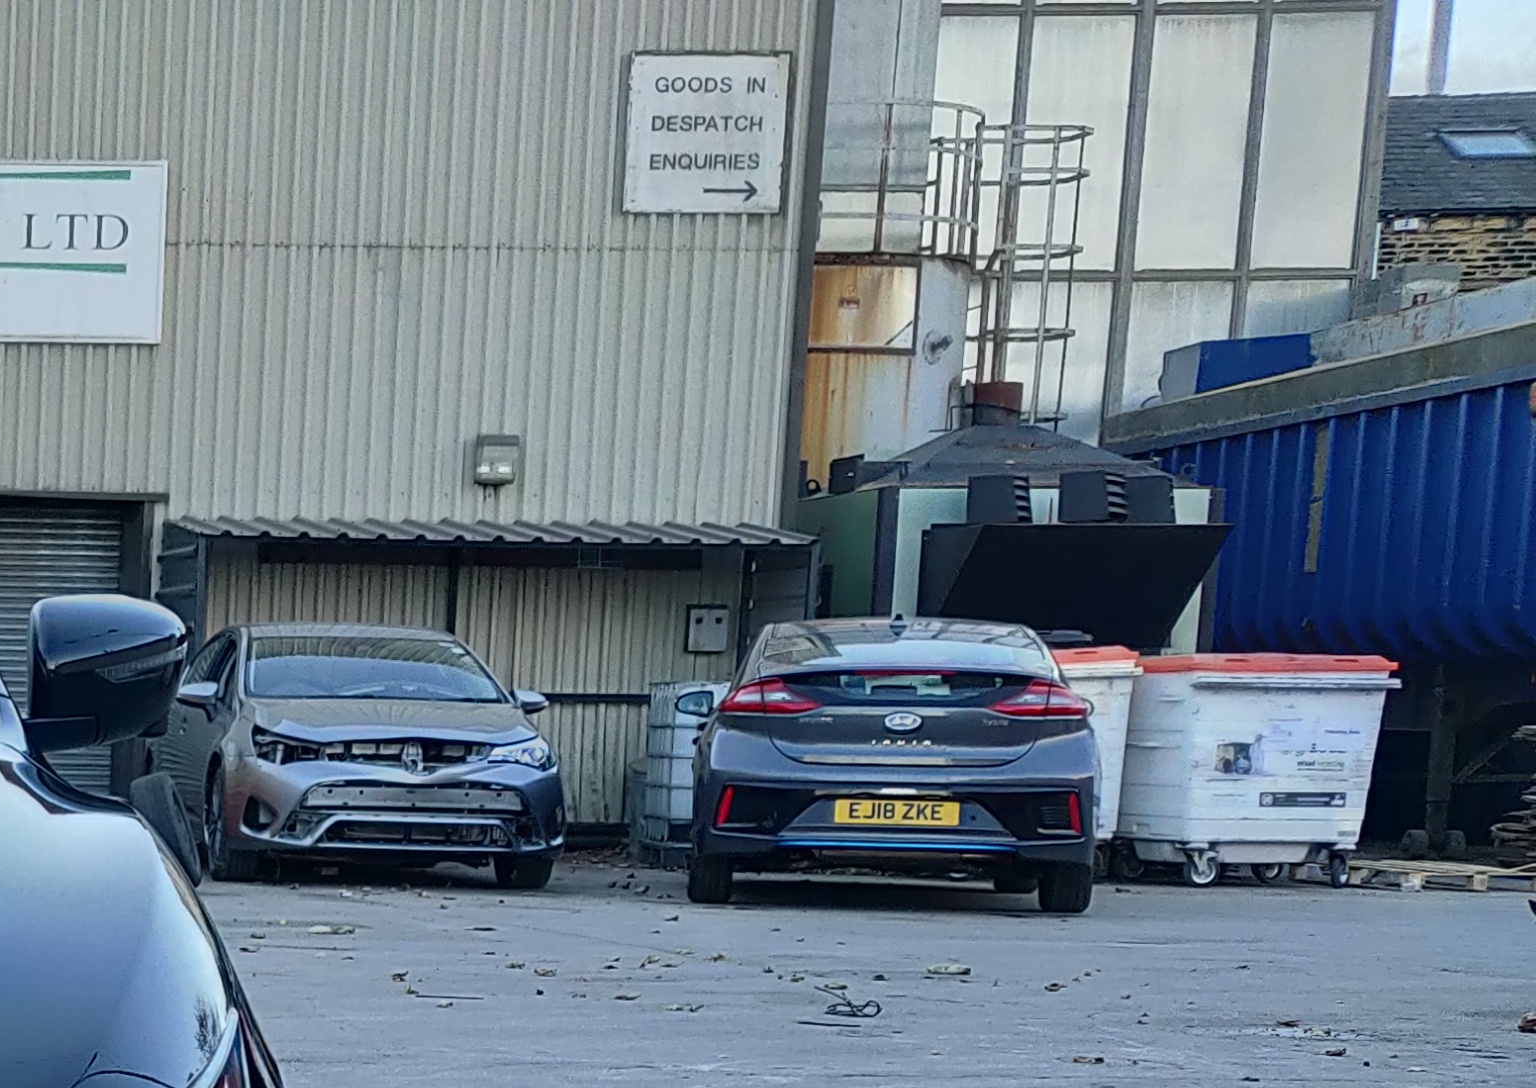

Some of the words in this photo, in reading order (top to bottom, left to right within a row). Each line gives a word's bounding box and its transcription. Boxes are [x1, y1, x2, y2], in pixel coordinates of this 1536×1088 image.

[655, 76, 732, 94] GOODS
[746, 76, 766, 94] IN
[651, 115, 763, 133] DESPATCH
[649, 152, 760, 171] ENQUIRIES
[21, 213, 129, 251] LTD
[848, 802, 896, 820] EJ18
[901, 803, 944, 821] ZKE
